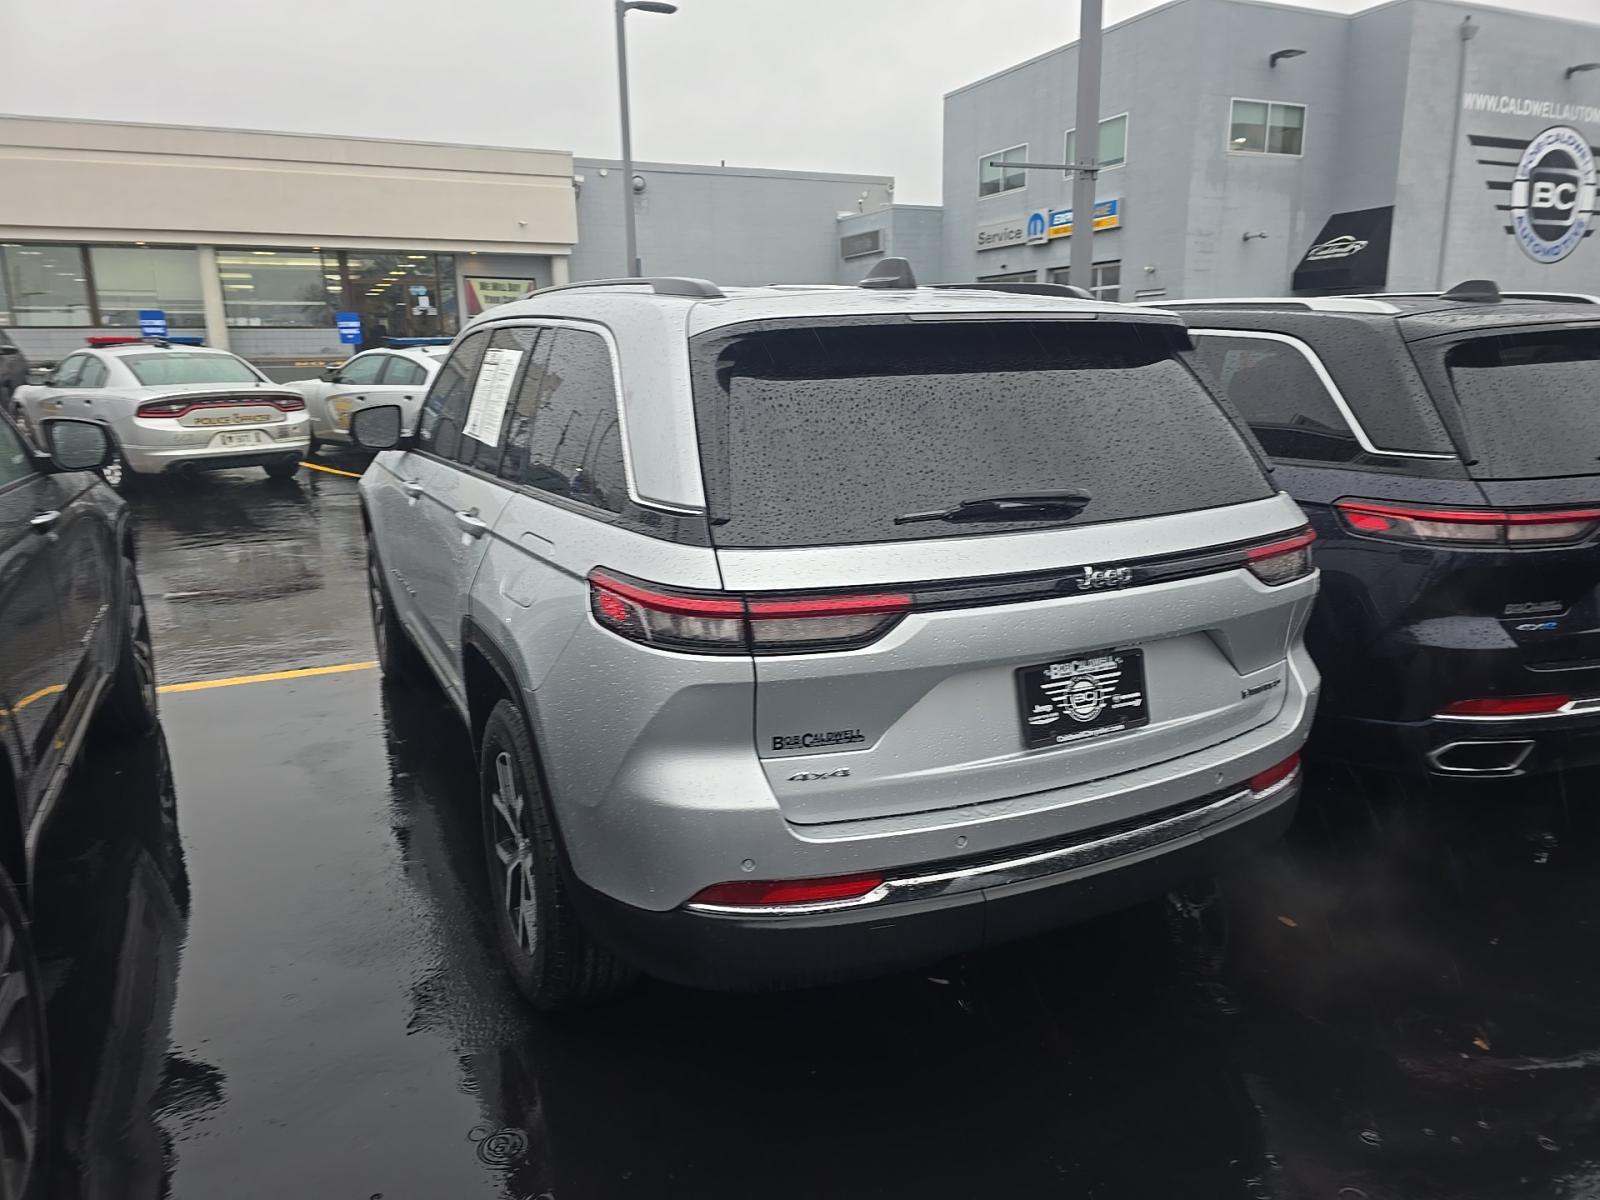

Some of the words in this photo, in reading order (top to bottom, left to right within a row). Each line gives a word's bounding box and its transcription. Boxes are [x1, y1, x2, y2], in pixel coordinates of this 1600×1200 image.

[1531, 182, 1577, 210] BC
[978, 228, 1023, 245] Service
[1076, 566, 1132, 589] Jeep
